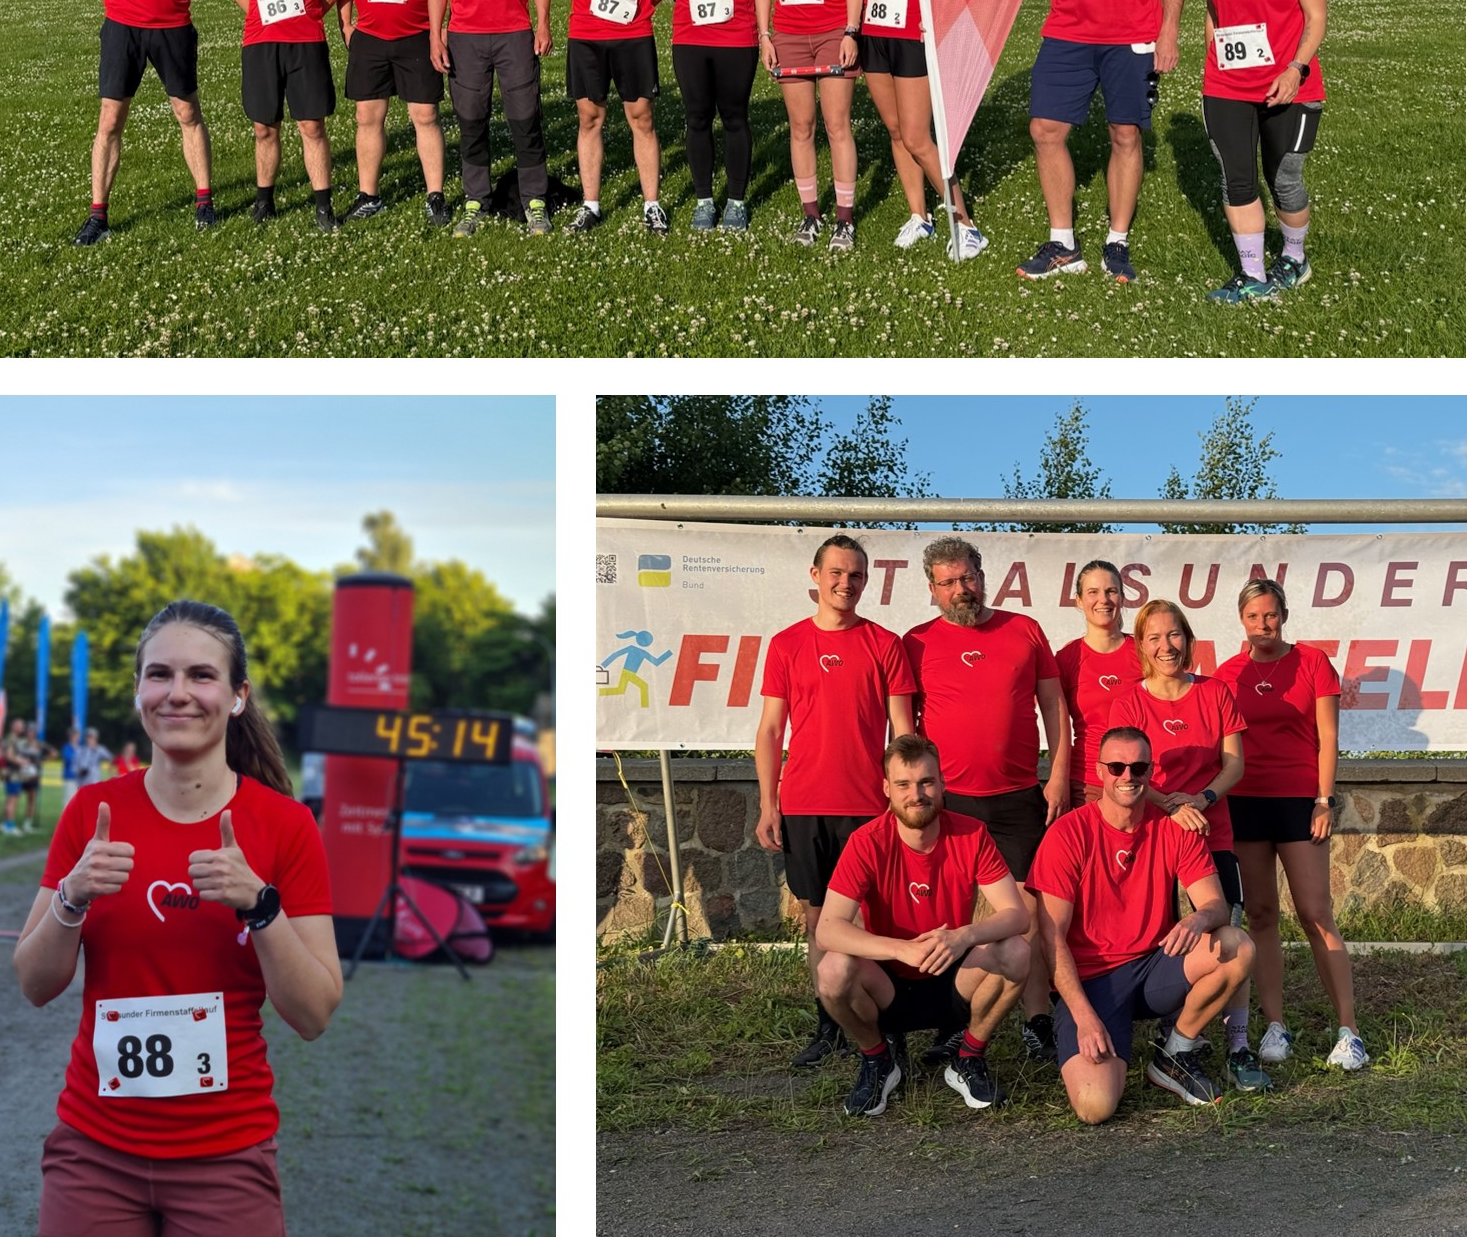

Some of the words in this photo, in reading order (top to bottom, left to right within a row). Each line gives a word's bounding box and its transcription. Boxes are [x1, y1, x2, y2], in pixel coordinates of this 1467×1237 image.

[267, 0, 288, 17] 86
[294, 2, 300, 11] 3
[623, 11, 630, 19] 2
[697, 2, 716, 18] 87
[724, 7, 730, 15] 3
[871, 2, 887, 19] 88
[894, 13, 900, 21] 2
[1224, 41, 1247, 61] 89
[1256, 48, 1265, 58] 2
[682, 555, 721, 563] Deutsche
[682, 564, 765, 574] Rentenversicherung
[682, 581, 704, 589] Bund
[375, 714, 500, 760] 45:14
[160, 893, 200, 911] AWO
[117, 1033, 174, 1079] 88
[197, 1052, 211, 1074] 3
